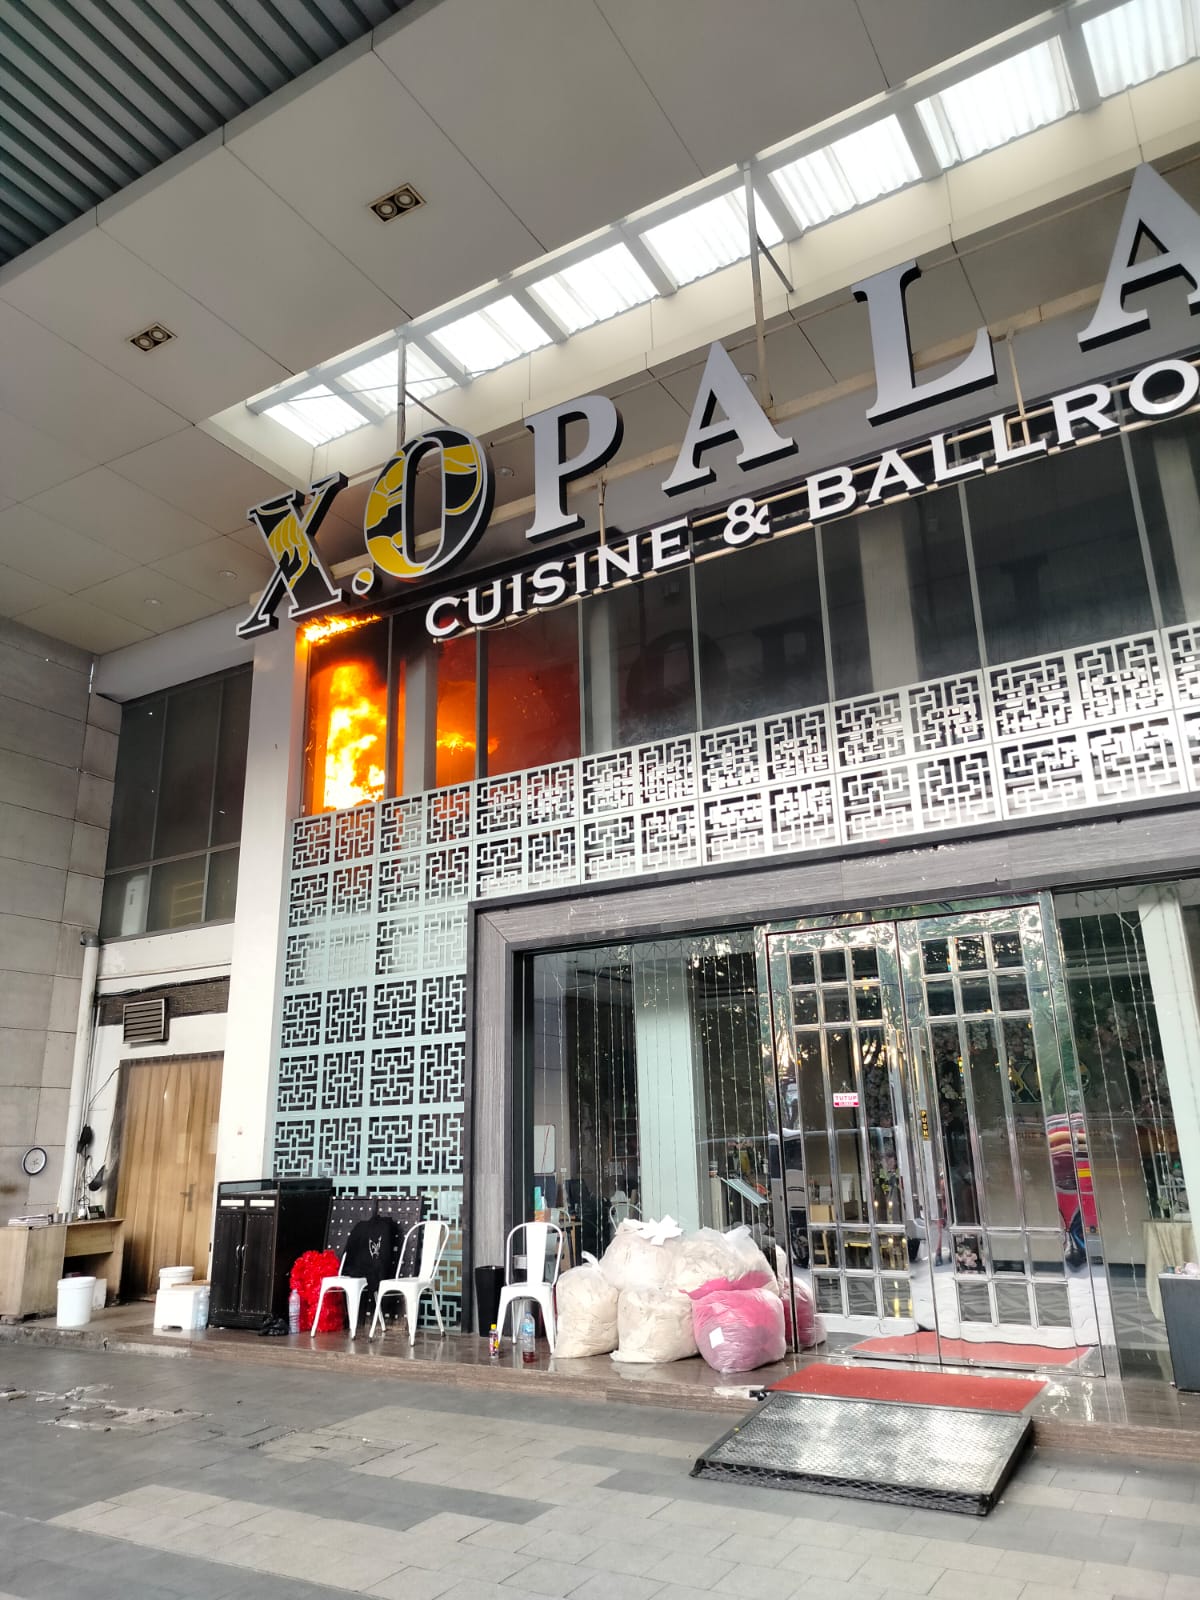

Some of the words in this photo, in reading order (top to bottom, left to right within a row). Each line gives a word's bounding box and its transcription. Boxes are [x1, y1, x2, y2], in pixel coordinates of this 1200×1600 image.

[424, 517, 696, 641] CUISINE
[723, 497, 771, 546] &
[805, 359, 1200, 521] BALLRO
